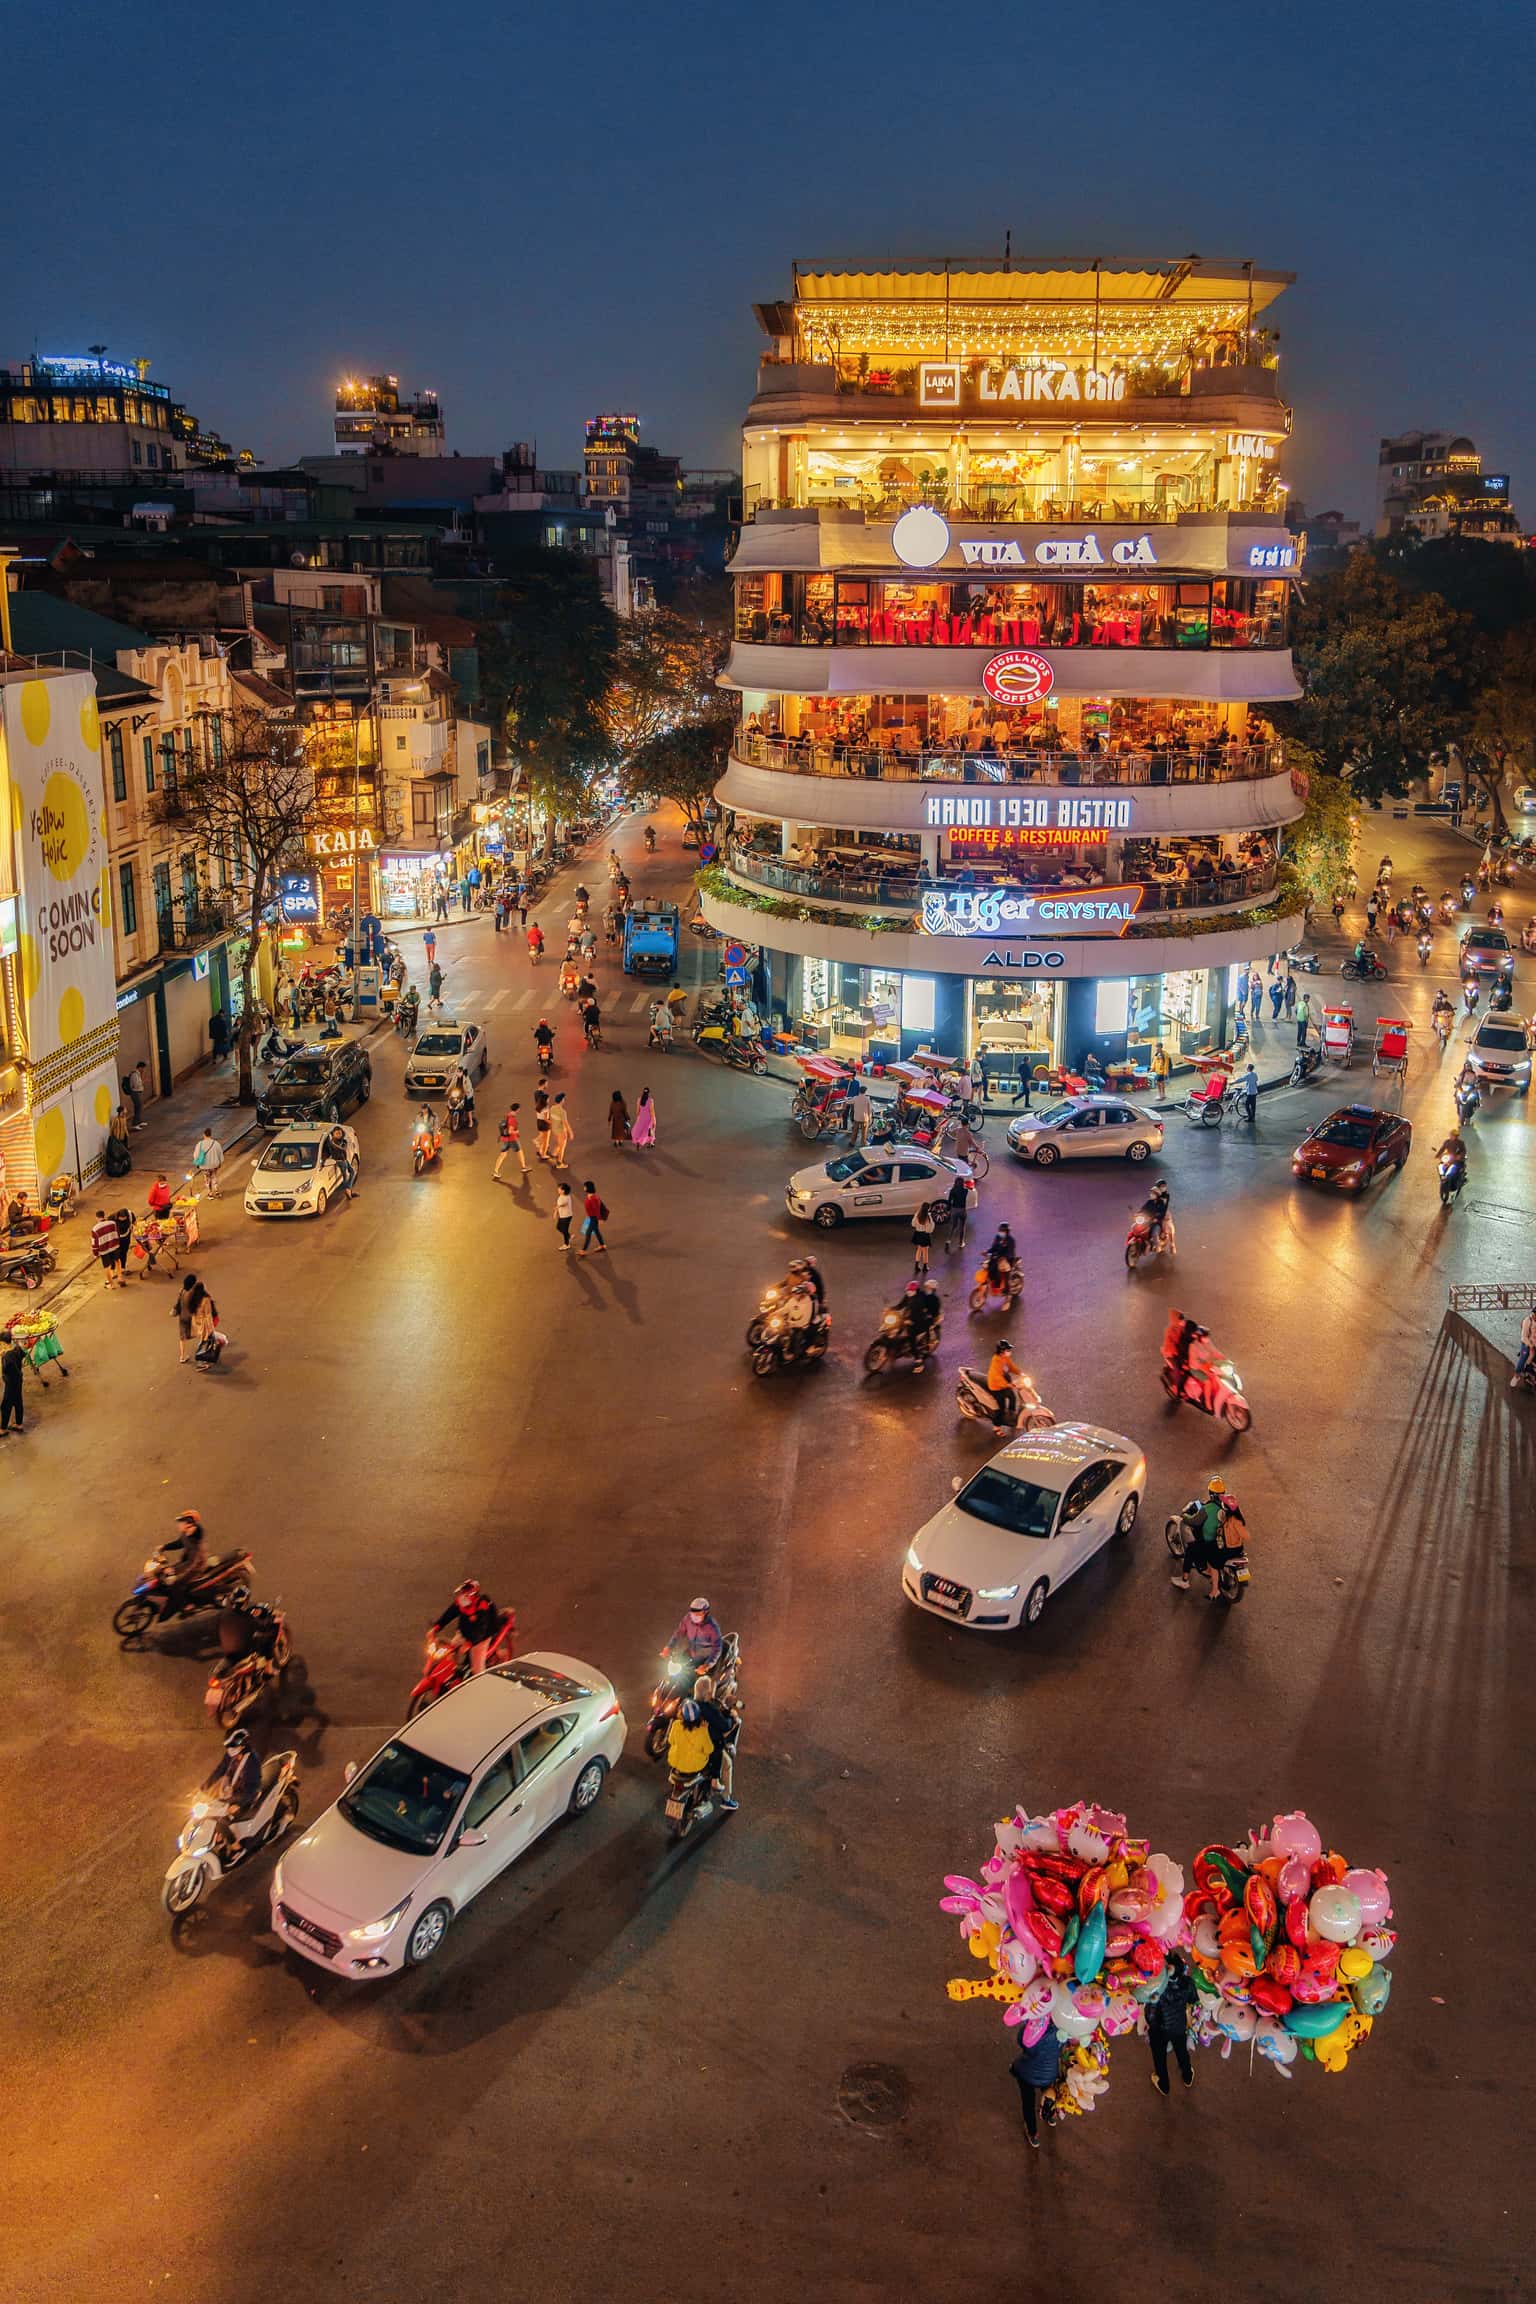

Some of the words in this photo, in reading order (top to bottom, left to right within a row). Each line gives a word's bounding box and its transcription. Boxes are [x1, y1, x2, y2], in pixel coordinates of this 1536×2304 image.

[926, 375, 954, 388] LAIKA
[980, 370, 1080, 400] LAIKA
[1228, 434, 1264, 458] LAIKA
[960, 541, 1026, 564] VUA
[1112, 535, 1157, 564] CÁ
[987, 654, 1050, 677] HIGHLANDS
[994, 689, 1042, 703] COFFEE
[30, 806, 65, 842] Yellow
[928, 799, 991, 825] HANOI
[999, 800, 1048, 826] 1930
[1058, 801, 1130, 828] BISTRO
[313, 829, 376, 855] KAIA
[949, 828, 1000, 844] COFFEE
[1004, 830, 1014, 844] &
[1019, 830, 1110, 845] RESTAURANT
[42, 839, 68, 867] Holic
[39, 887, 101, 935] COMING
[285, 897, 317, 911] SPA
[949, 890, 1035, 932] Tiger
[1039, 902, 1136, 920] CRYSTAL
[50, 920, 95, 962] SOON
[982, 951, 1065, 968] ALDO
